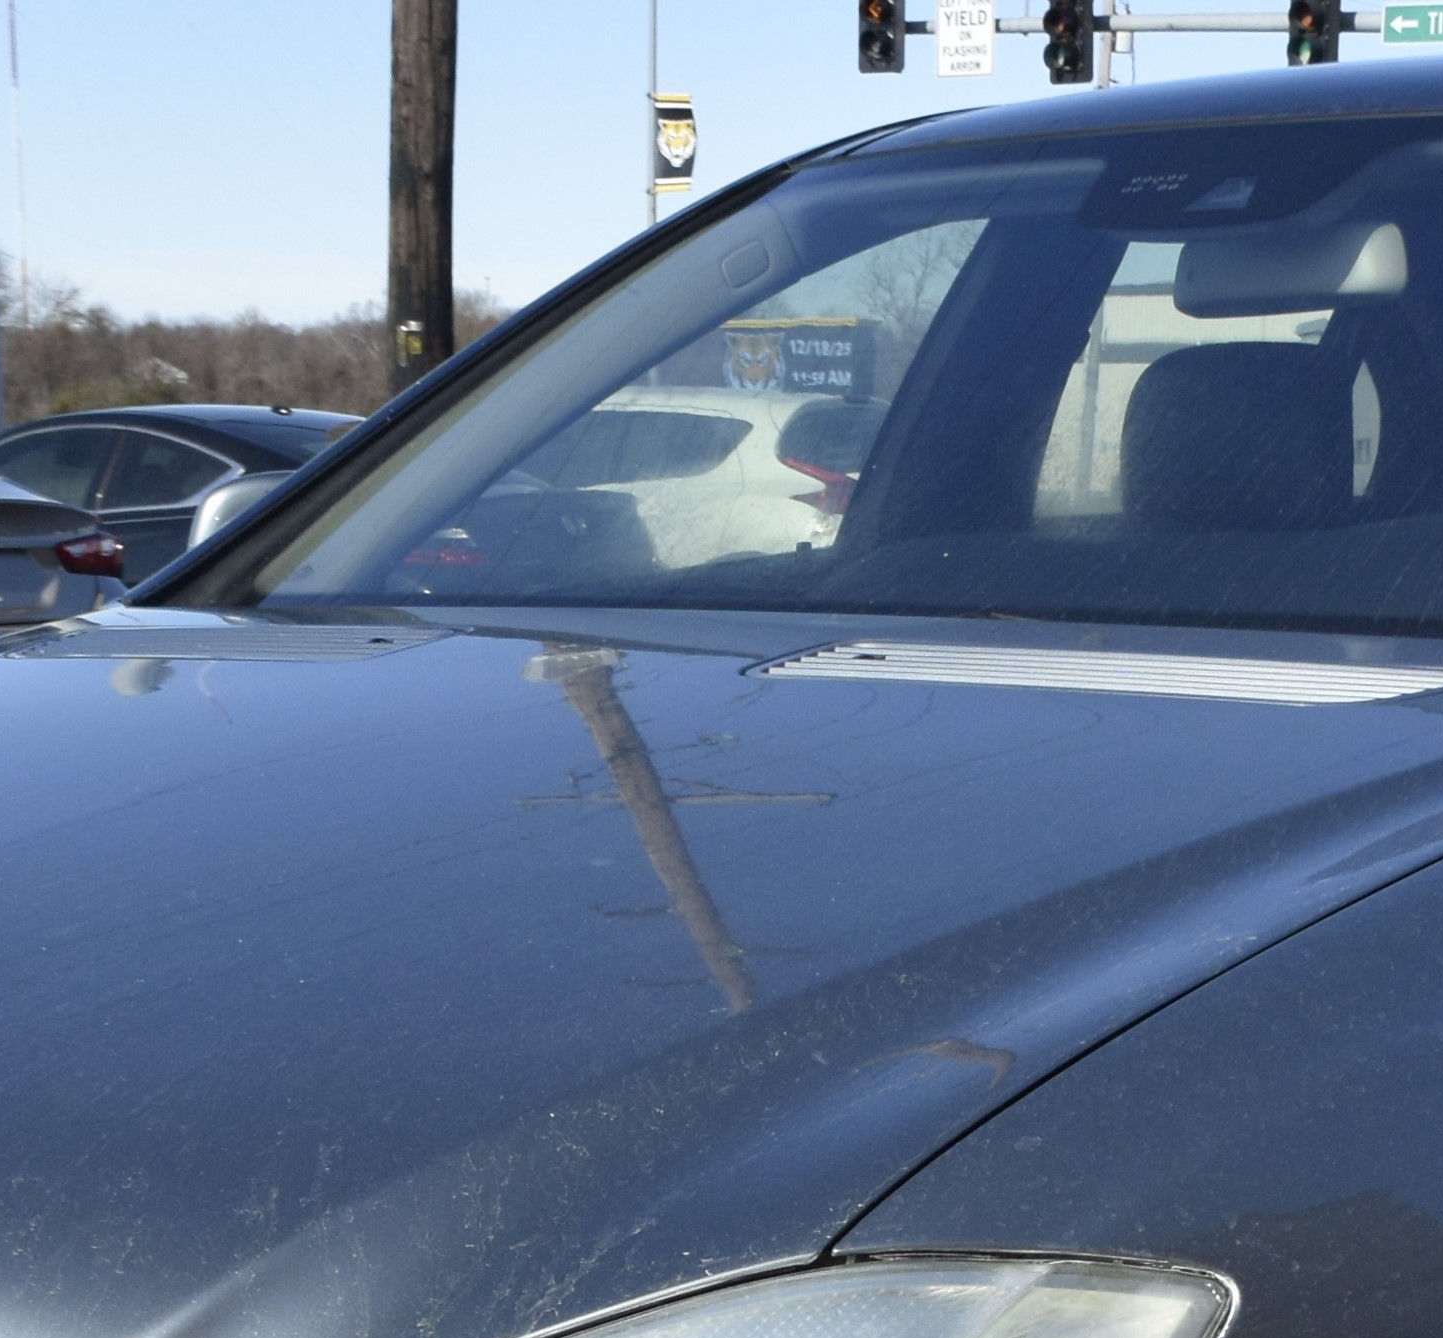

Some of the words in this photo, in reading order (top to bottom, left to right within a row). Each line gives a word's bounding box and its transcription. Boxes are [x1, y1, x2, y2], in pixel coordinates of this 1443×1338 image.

[944, 10, 987, 27] YIELD
[958, 30, 972, 41] ON
[942, 44, 988, 57] FLASHING
[950, 61, 981, 71] ARROW
[790, 339, 852, 356] 12/18/25
[827, 370, 852, 386] AM
